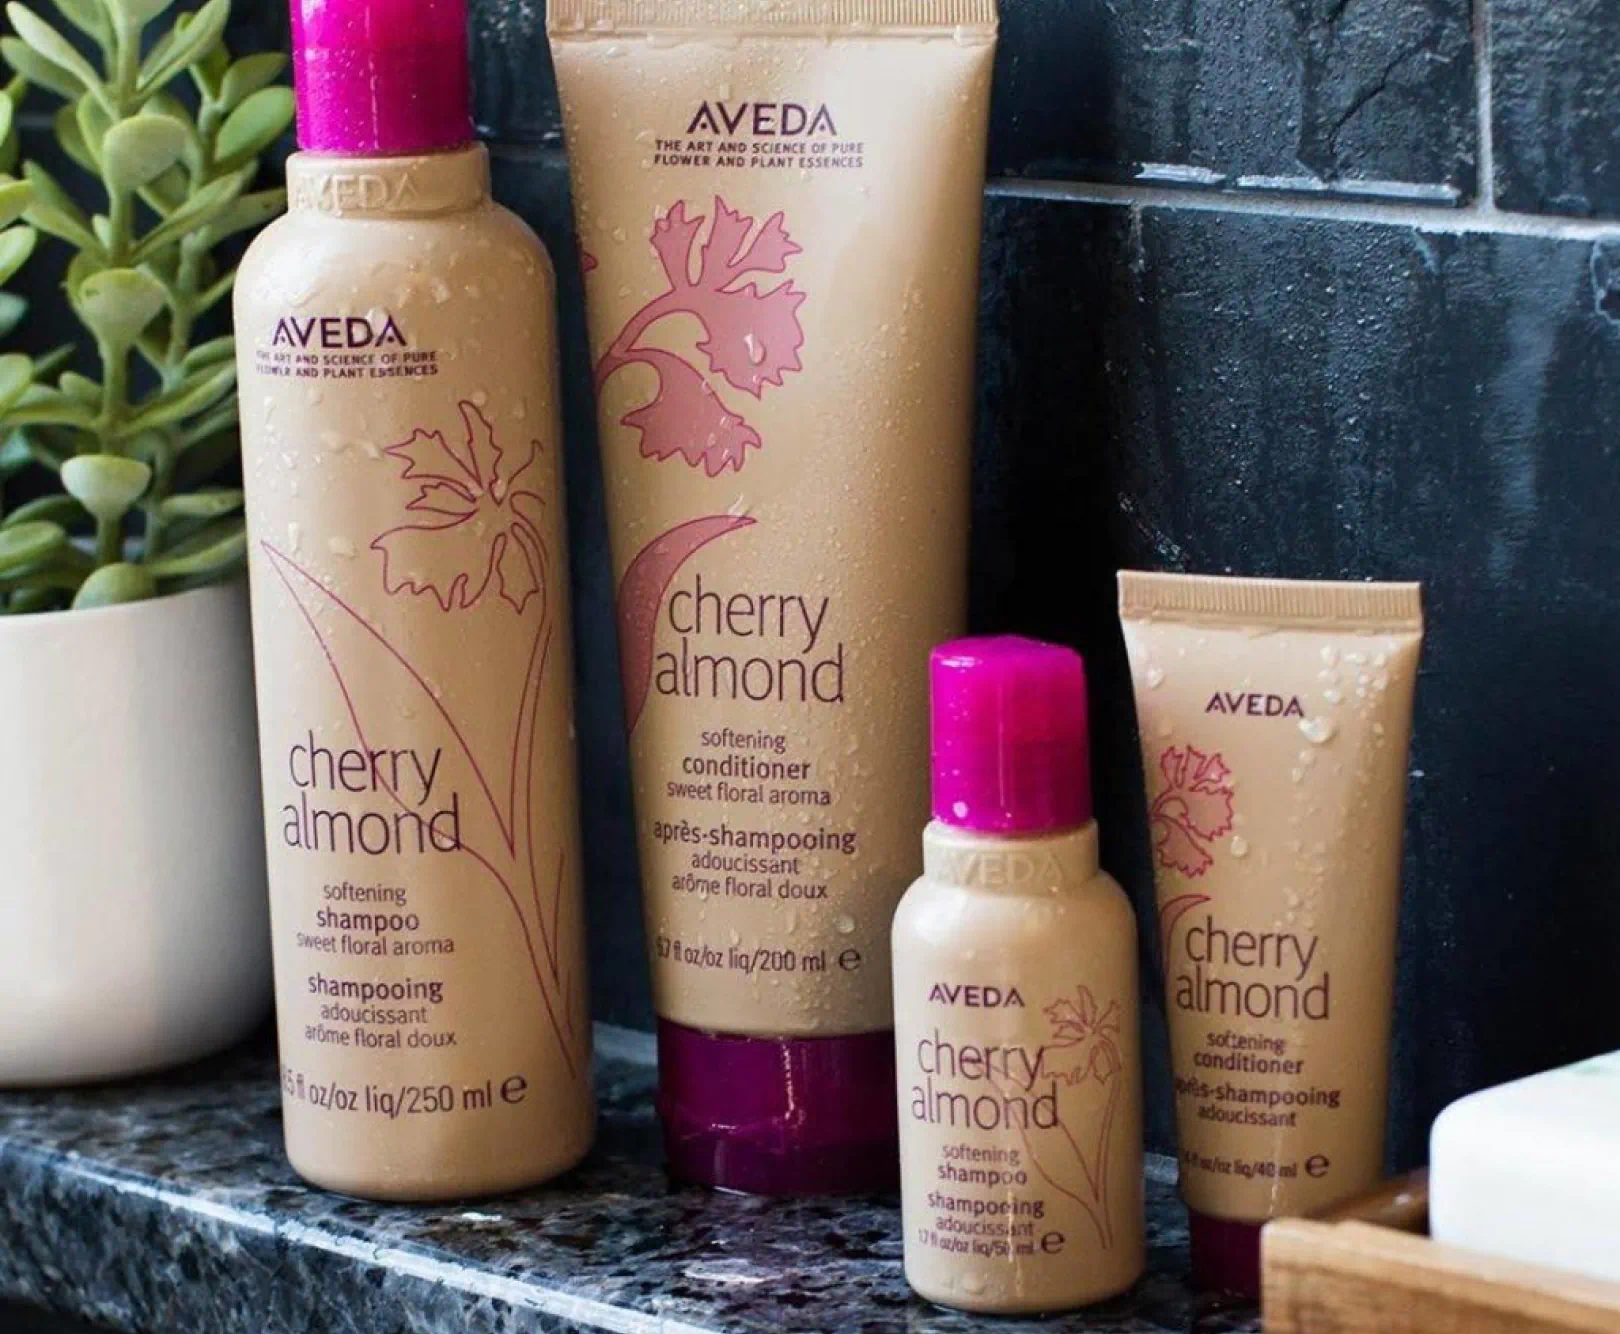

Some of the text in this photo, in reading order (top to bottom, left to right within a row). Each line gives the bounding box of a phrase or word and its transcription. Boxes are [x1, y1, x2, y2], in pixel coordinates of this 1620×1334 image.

[686, 100, 837, 136] AVEDA
[655, 140, 864, 154] THE ART AND SCIENCE OF PURE
[654, 153, 864, 168] FLOWER AND PLANT ESSENCES
[296, 172, 418, 211] AVEDA
[272, 315, 407, 348] AVEDA
[296, 354, 318, 365] AND
[323, 354, 375, 366] SCIENCE
[381, 353, 398, 365] OF
[403, 351, 436, 363] PURE
[296, 367, 318, 378] AND
[323, 367, 364, 378] PLANT
[370, 364, 438, 378] ESSENCES
[669, 573, 829, 654] cherry
[655, 637, 844, 703] almond
[1205, 692, 1305, 718] AVEDA
[701, 728, 786, 755] softening
[290, 730, 442, 806] cherry
[682, 754, 811, 780] conditioner
[667, 781, 832, 805] sweet floral aroma
[283, 791, 461, 855] almond
[653, 819, 856, 855] après-shampooing
[691, 852, 800, 875] adoucissant
[323, 882, 407, 907] softening
[672, 872, 828, 899] arôme floral doux
[317, 906, 420, 936] shampoo
[297, 932, 455, 956] sweet floral aroma
[1185, 915, 1318, 982] cherry
[684, 943, 723, 968] oz/oz
[729, 946, 795, 974] liq/200
[802, 950, 826, 973] ml
[308, 972, 444, 1004] shampooing
[928, 983, 1025, 1008] AVEDA
[1176, 965, 1329, 1020] almond
[320, 1003, 428, 1025] adoucissant
[305, 1023, 457, 1049] arôme floral doux
[1207, 1029, 1285, 1056] softening
[918, 1028, 1045, 1091] cherry
[1194, 1051, 1304, 1074] conditioner
[309, 1081, 358, 1110] oz/oz
[365, 1084, 454, 1120] liq/250
[462, 1079, 492, 1109] ml
[911, 1076, 1058, 1130] almond
[1197, 1104, 1296, 1127] adoucissant
[942, 1143, 1020, 1166] softening
[938, 1163, 1028, 1188] shampoo
[1279, 1162, 1297, 1177] ml
[927, 1190, 1045, 1219] shampooing
[936, 1215, 1034, 1237] adoucissant
[940, 1236, 969, 1252] oz/oz
[1016, 1240, 1034, 1254] ml
